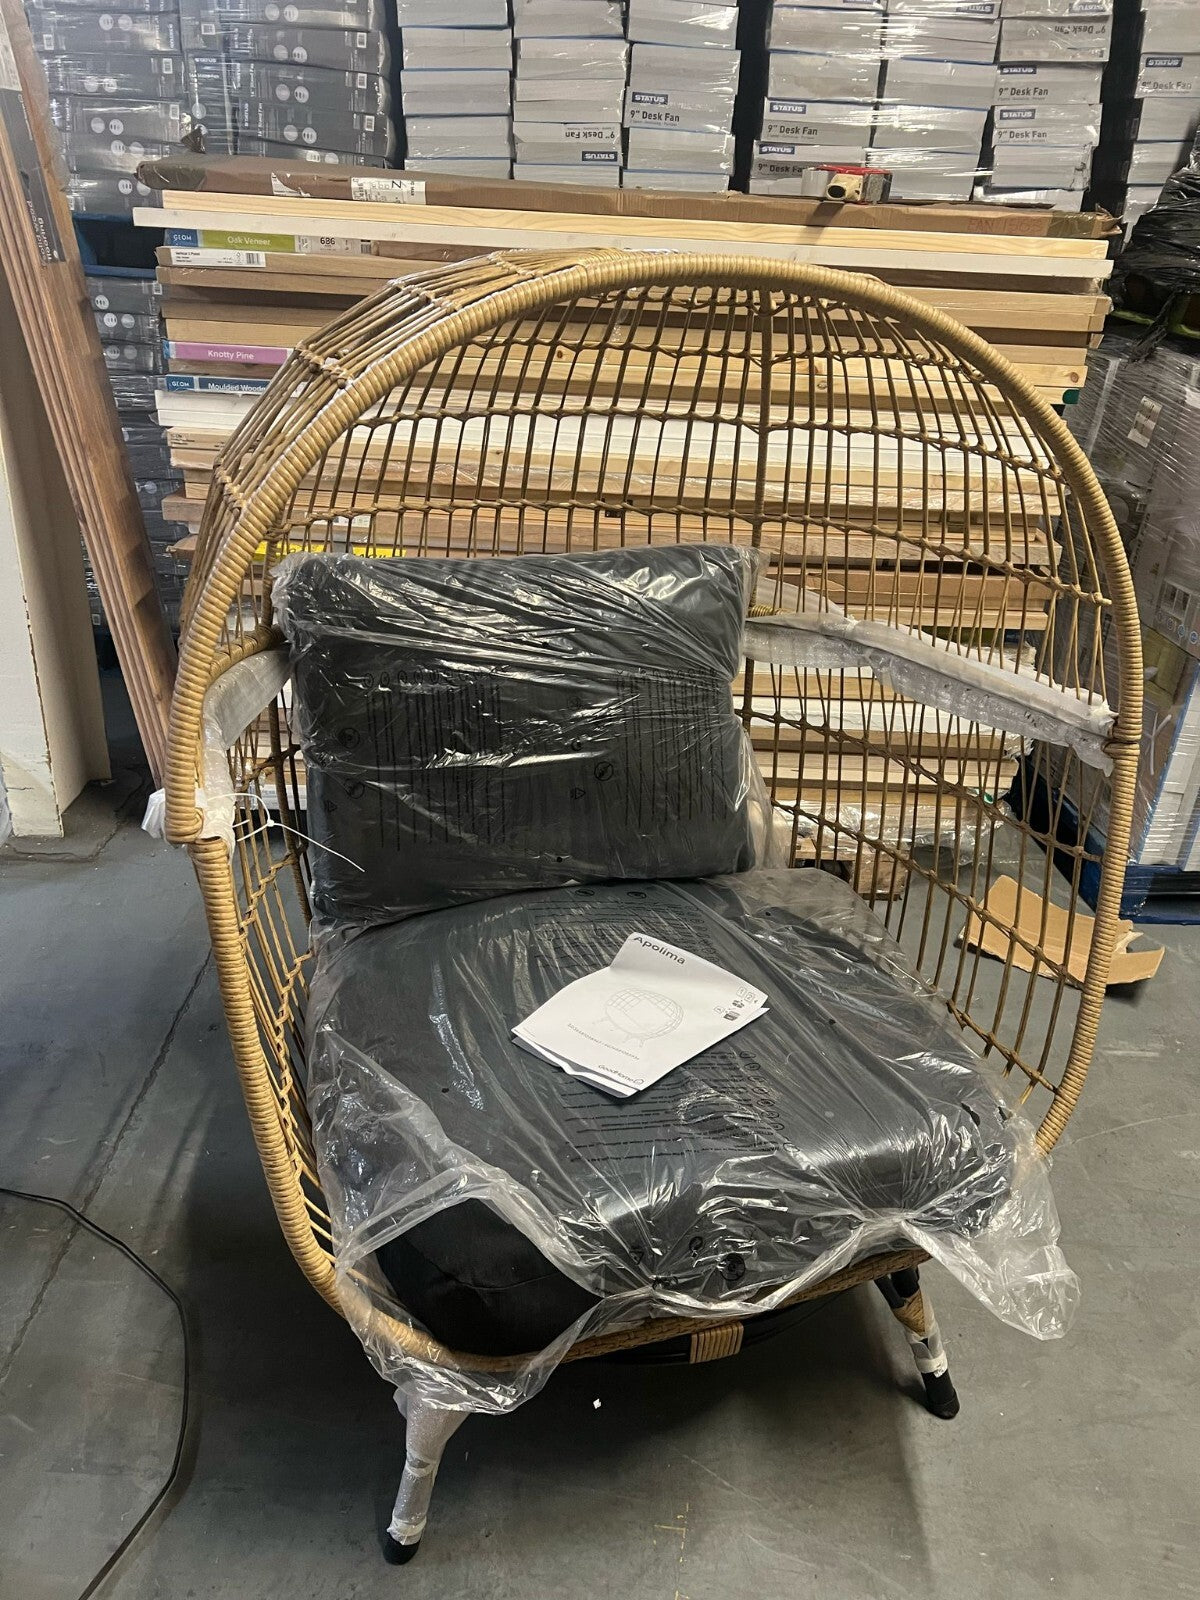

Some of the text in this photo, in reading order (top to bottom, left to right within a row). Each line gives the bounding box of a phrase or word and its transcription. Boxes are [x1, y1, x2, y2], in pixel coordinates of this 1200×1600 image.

[1072, 25, 1094, 34] Desk
[1153, 82, 1174, 90] Desk
[1176, 82, 1192, 90] Fan
[1010, 87, 1031, 96] Desk
[1033, 87, 1049, 96] Fan
[634, 94, 666, 103] STATUS
[772, 104, 804, 112] STATUS
[642, 110, 662, 121] Desk
[664, 112, 680, 122] Fan
[565, 131, 580, 139] Fan
[582, 131, 603, 139] Desk
[780, 125, 800, 135] Desk
[802, 126, 818, 136] Fan
[1009, 131, 1030, 139] Desk
[761, 145, 793, 153] STATUS
[769, 164, 790, 173] Desk
[227, 236, 271, 246] Oak Veneer
[207, 350, 255, 360] Knotty Pine
[208, 382, 240, 391] Moulded
[633, 936, 686, 965] Apolima
